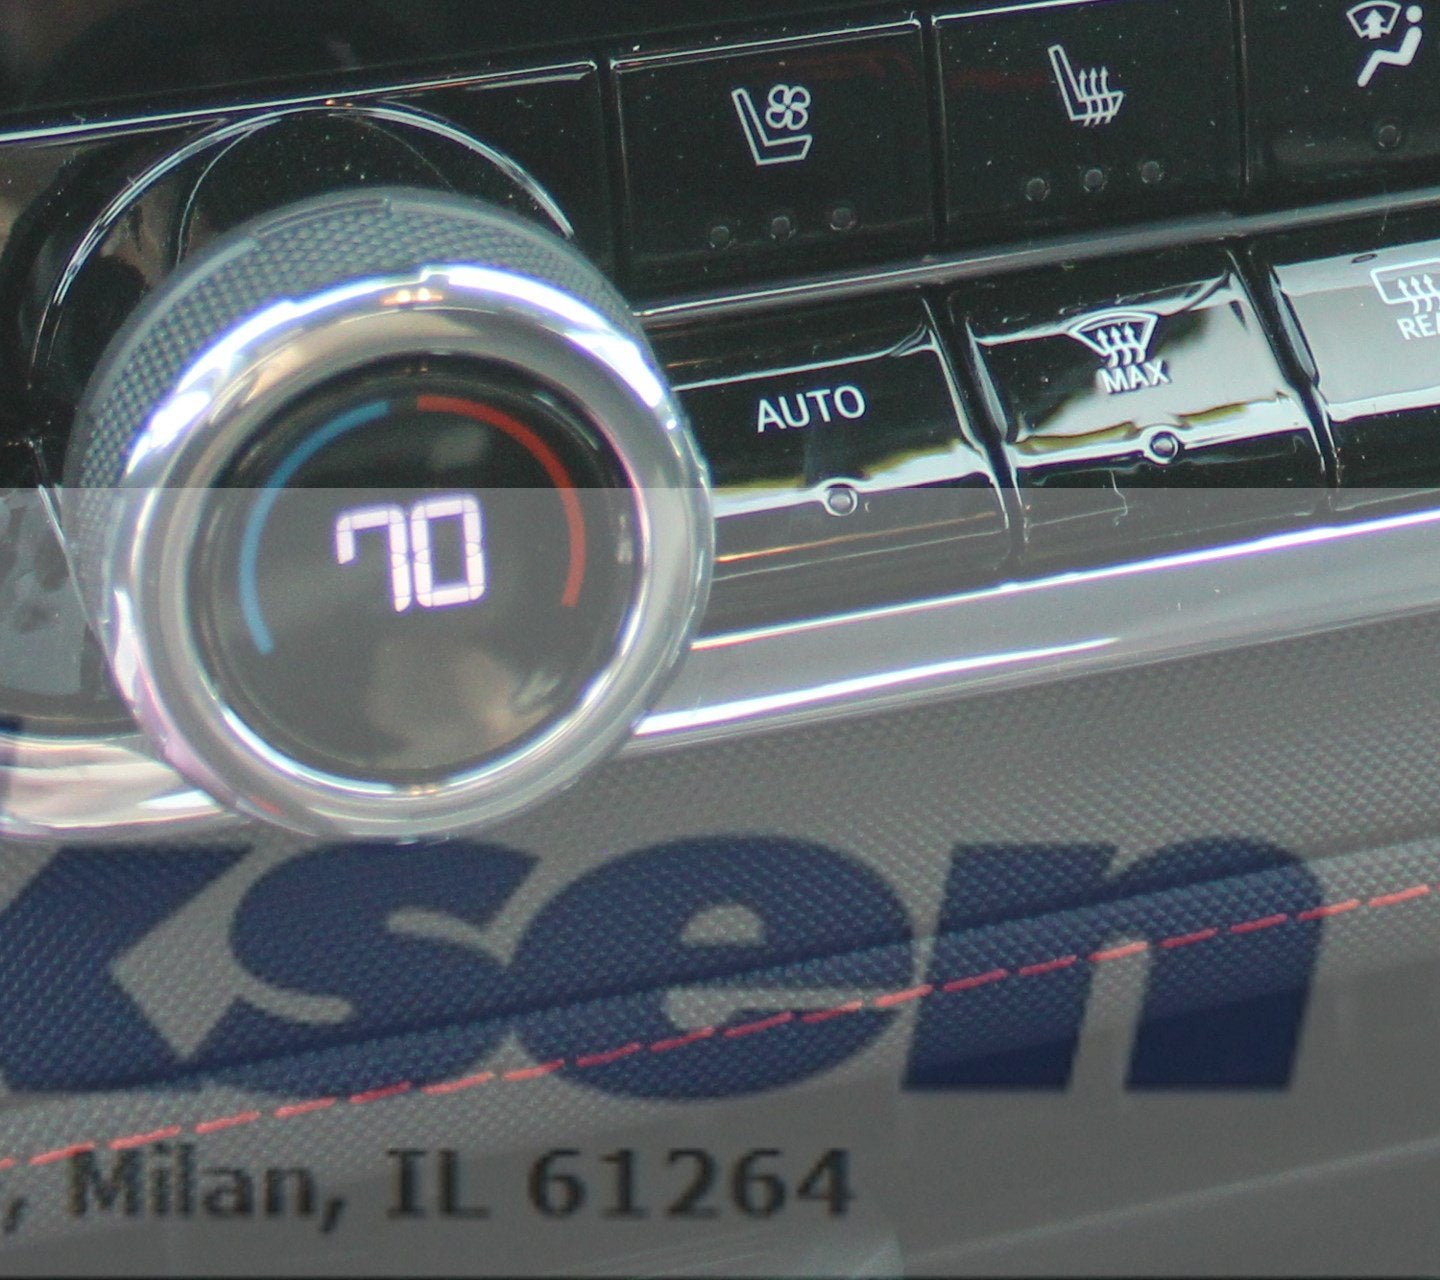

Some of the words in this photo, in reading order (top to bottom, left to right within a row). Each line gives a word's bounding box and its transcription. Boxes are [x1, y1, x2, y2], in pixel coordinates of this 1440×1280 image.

[1100, 361, 1170, 395] MAX
[756, 385, 867, 433] AUTO
[335, 493, 486, 613] 70
